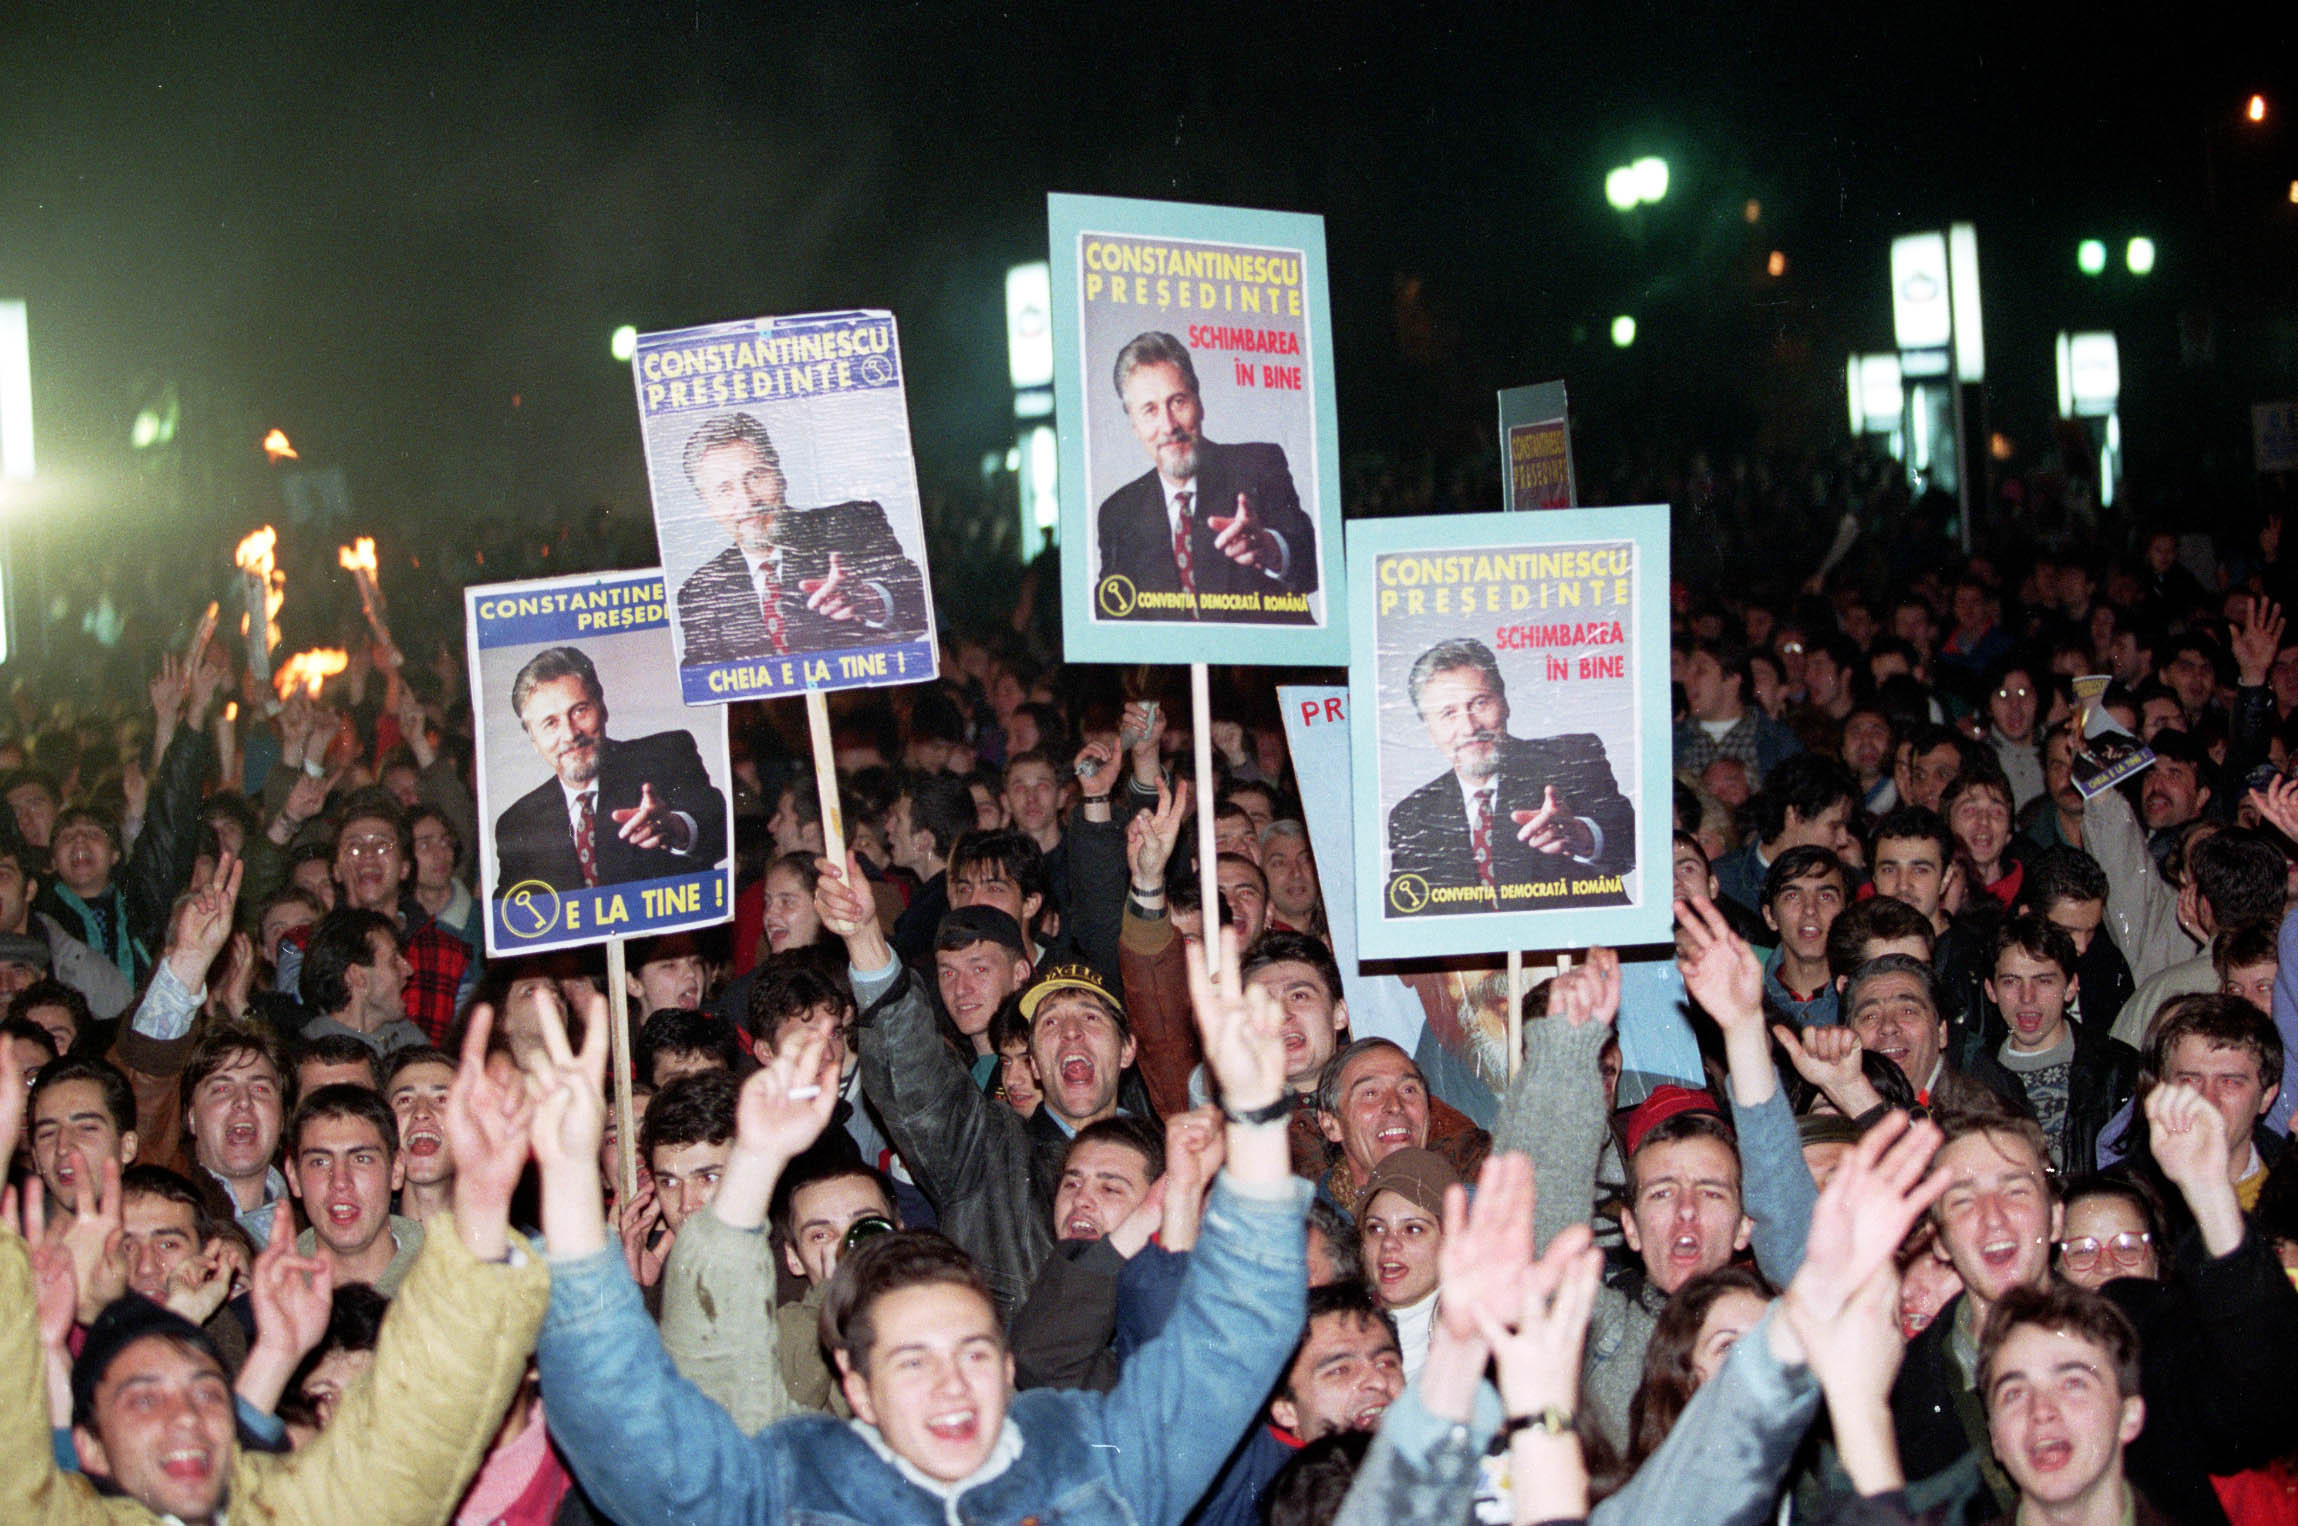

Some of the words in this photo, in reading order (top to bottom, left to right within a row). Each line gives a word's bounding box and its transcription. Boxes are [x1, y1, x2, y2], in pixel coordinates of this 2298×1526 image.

[1086, 241, 1299, 287] CONSTANTINESCU
[1087, 273, 1302, 316] PREȘEDINTE
[643, 326, 890, 382] CONSTANTINESCU
[1188, 324, 1300, 356] SCHIMBAREA
[1233, 356, 1255, 387] ÎN
[1263, 364, 1302, 390] BINE
[1379, 549, 1629, 587] CONSTANTINESCU
[479, 583, 665, 620] CONSTANTINE
[1380, 578, 1629, 618] PREȘEDINTE
[577, 603, 670, 631] PREȘEDI
[1496, 621, 1624, 650] SCHIMBAREA
[708, 664, 773, 693] CHEIA
[782, 661, 793, 685] E
[804, 658, 830, 683] LA
[839, 652, 887, 680] TINE
[1546, 653, 1568, 681] ÎN
[1579, 655, 1624, 680] BINE
[1300, 693, 1351, 728] PR
[566, 899, 580, 930] E
[595, 893, 630, 926] LA
[644, 883, 702, 919] TINE
[1501, 877, 1568, 899] DEMOCRATĂ
